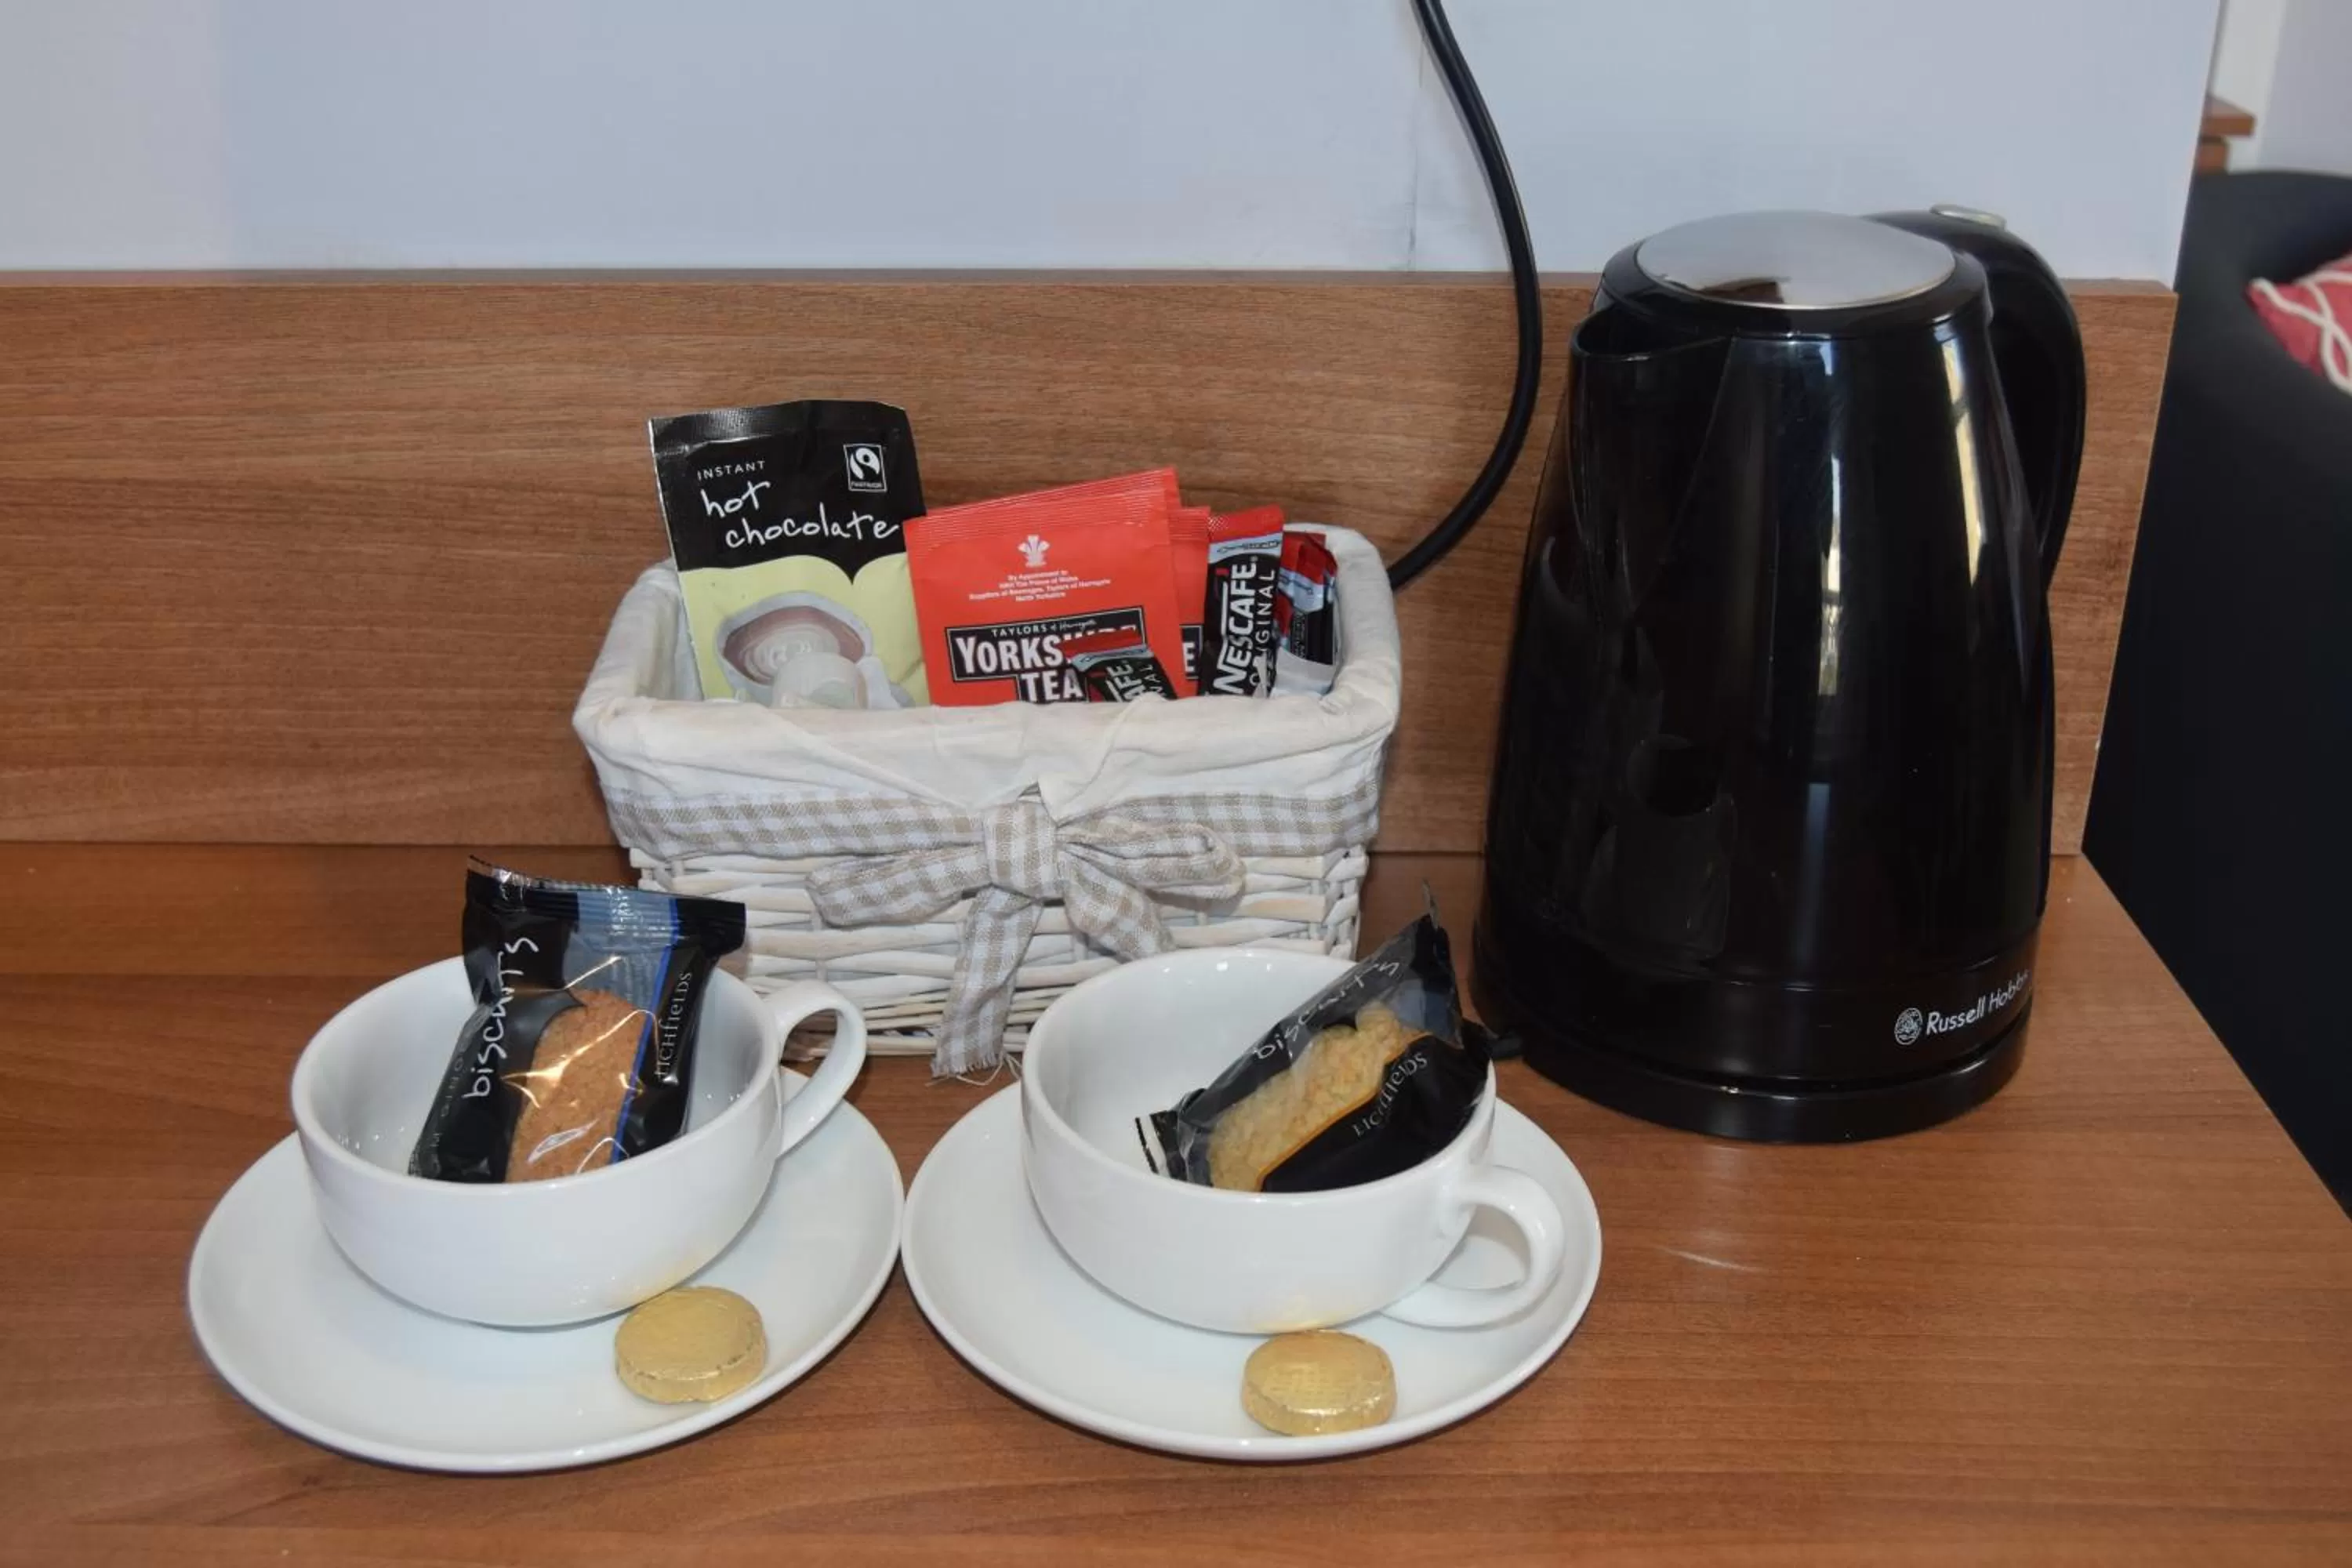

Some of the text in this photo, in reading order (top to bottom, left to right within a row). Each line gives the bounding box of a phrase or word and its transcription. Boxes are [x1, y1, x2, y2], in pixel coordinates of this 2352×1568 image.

[697, 460, 766, 481] INSTANT
[700, 481, 771, 518] hot
[726, 502, 899, 548] chocolate
[991, 623, 1047, 637] TAYLORS
[1249, 570, 1276, 686] OIGINAL
[1020, 668, 1084, 702] TEA
[1926, 995, 1986, 1036] Russell
